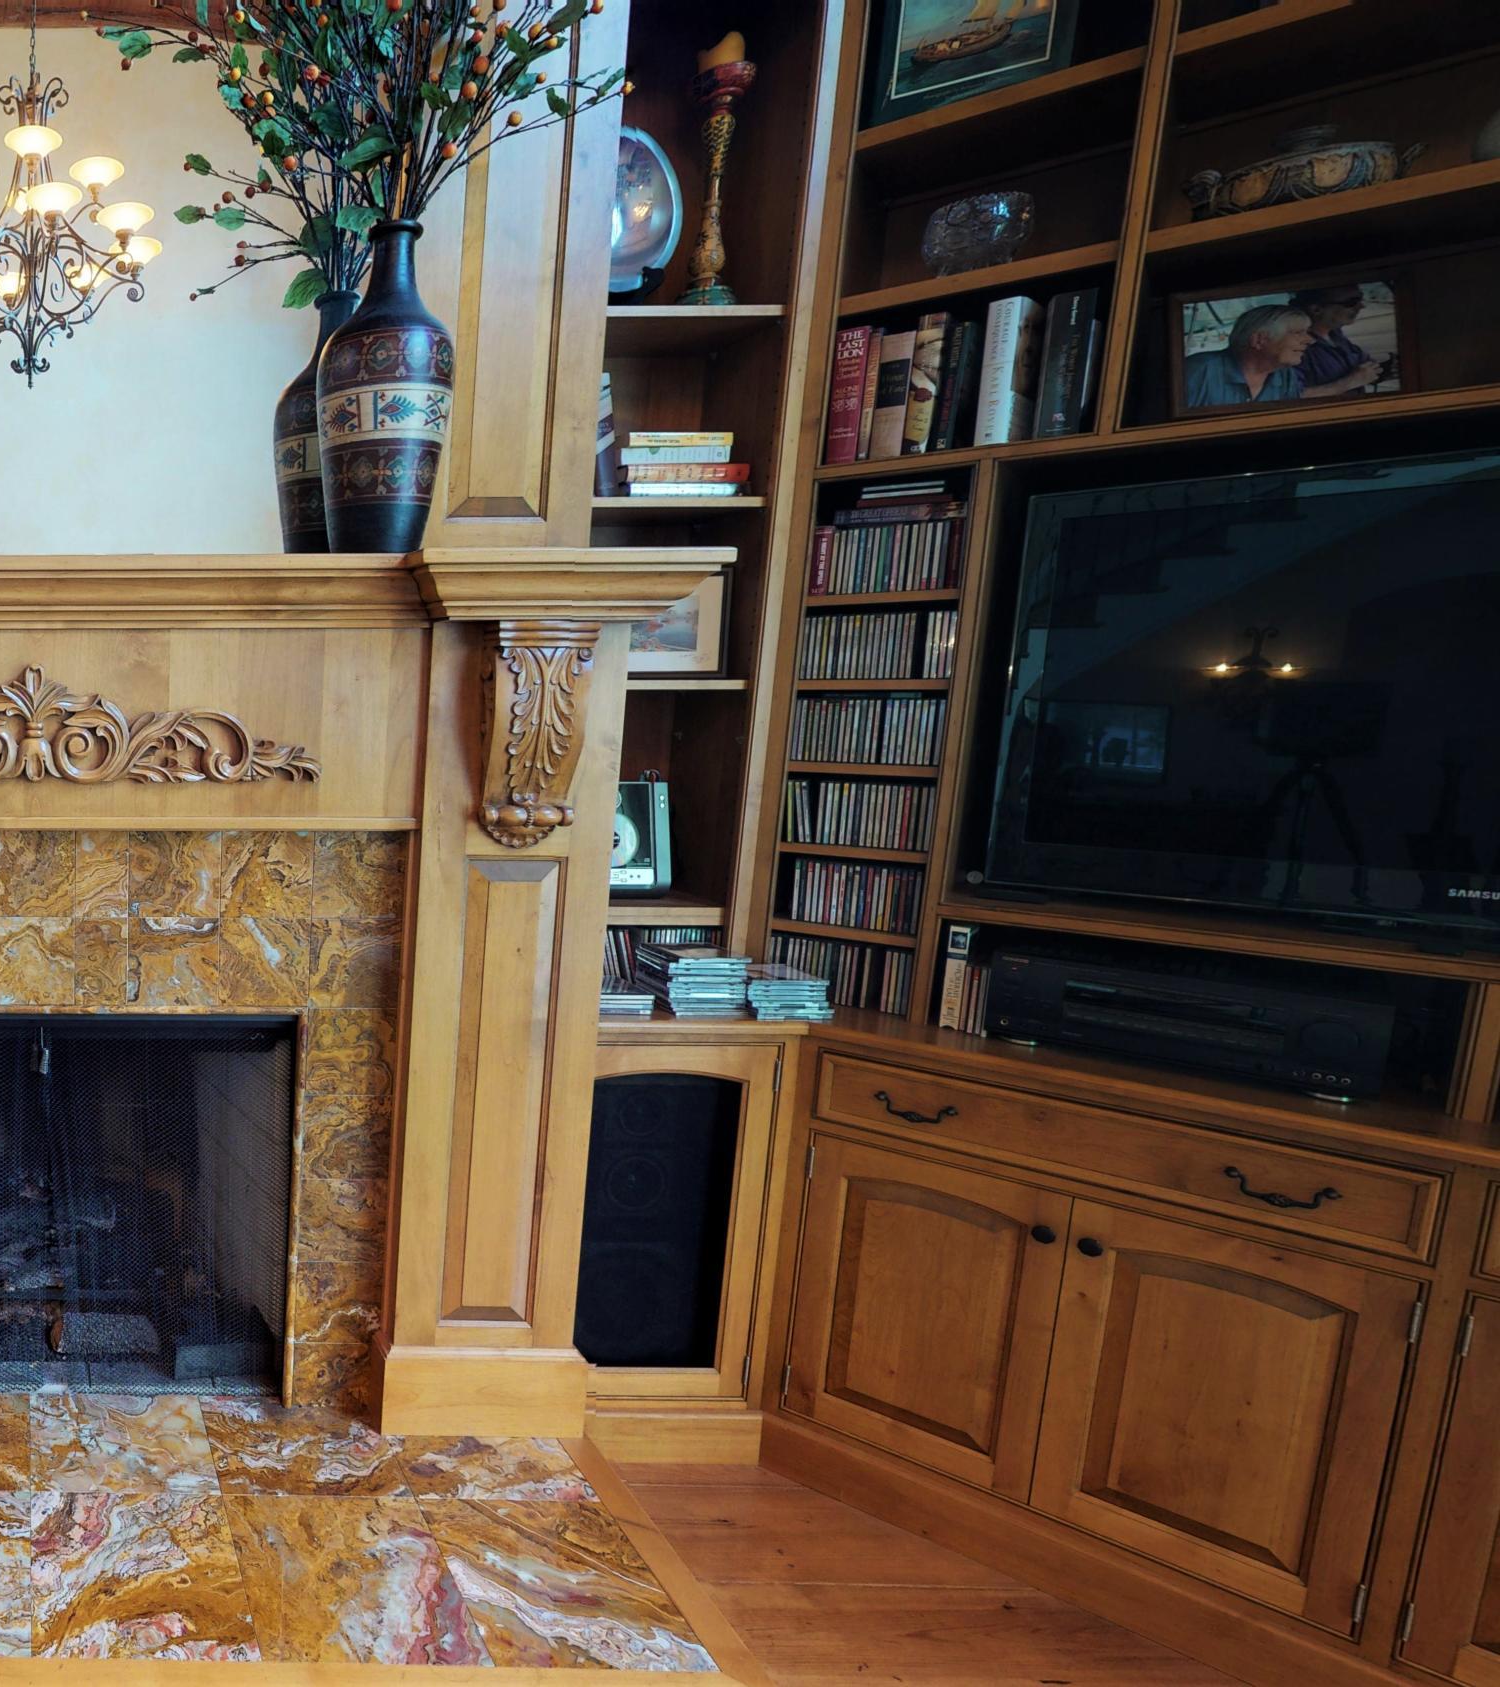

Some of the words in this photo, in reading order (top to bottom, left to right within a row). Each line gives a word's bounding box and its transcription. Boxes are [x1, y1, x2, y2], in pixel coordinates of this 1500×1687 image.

[842, 330, 864, 341] THE
[837, 339, 865, 350] LAST
[837, 348, 864, 360] LION
